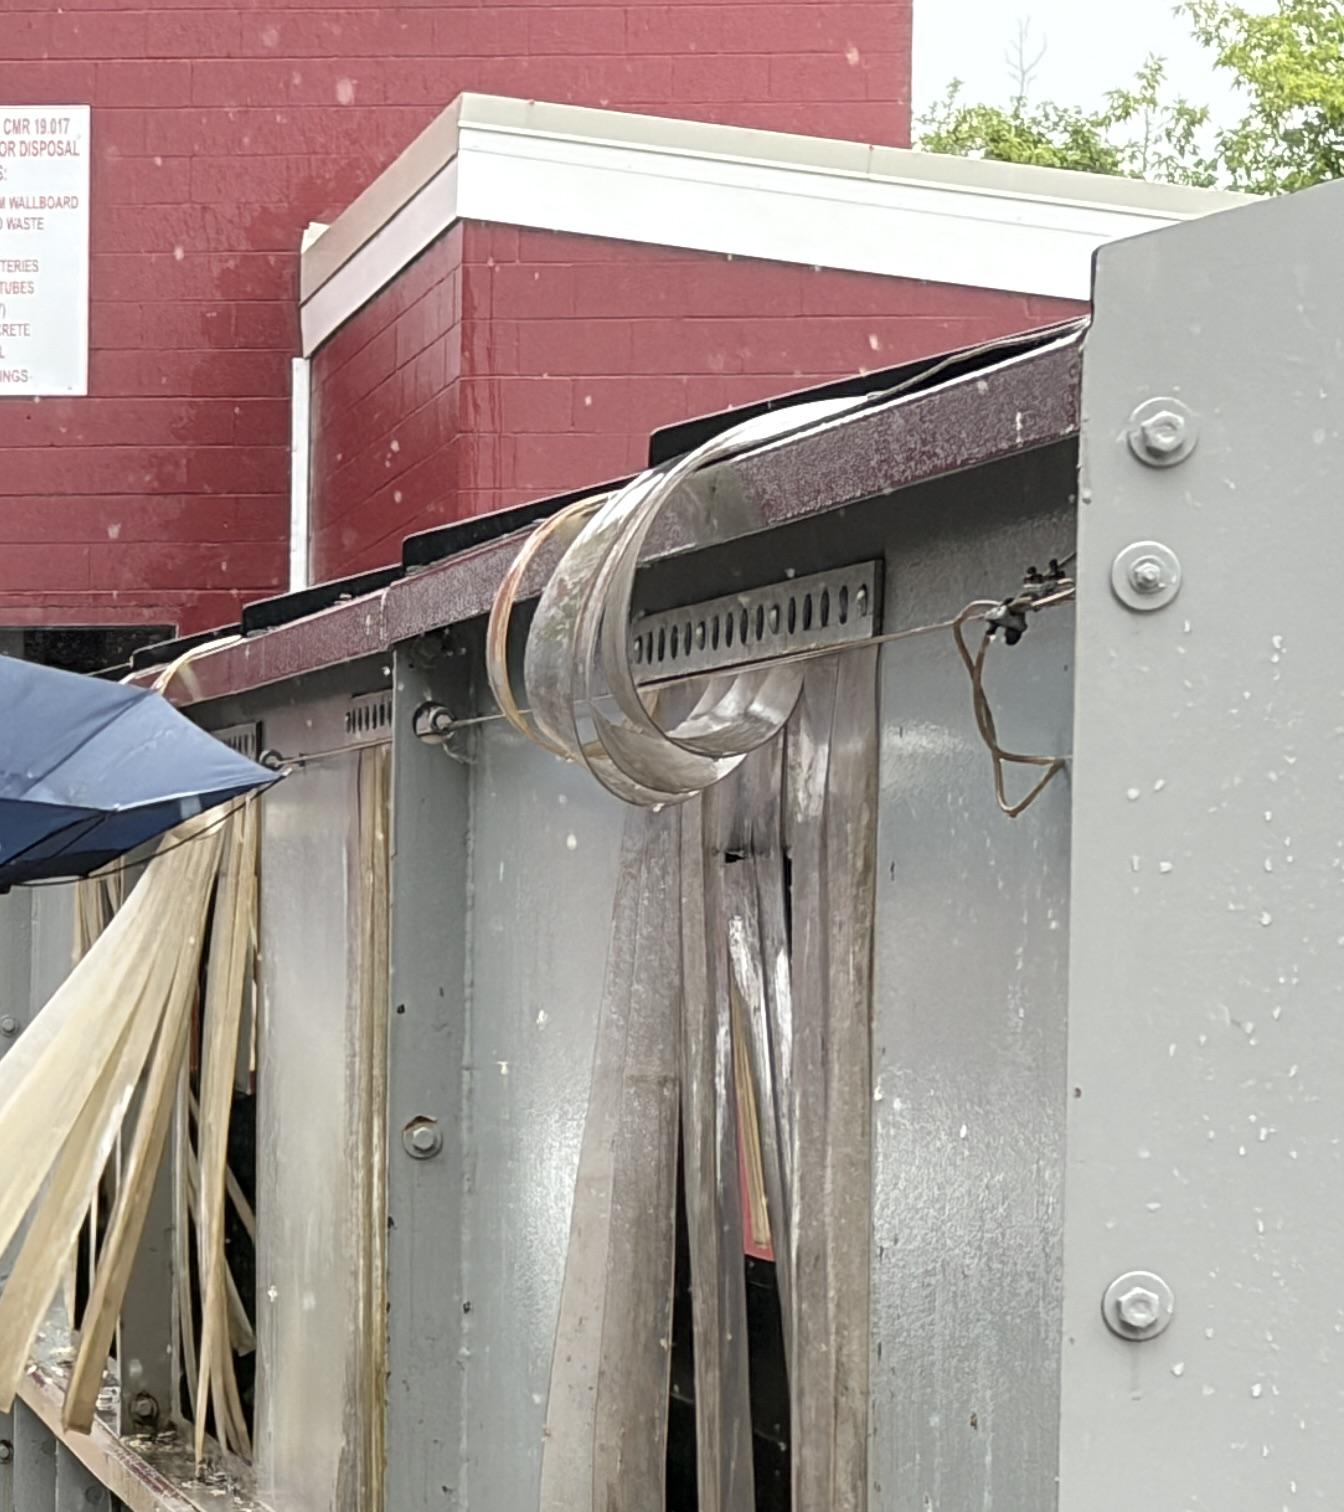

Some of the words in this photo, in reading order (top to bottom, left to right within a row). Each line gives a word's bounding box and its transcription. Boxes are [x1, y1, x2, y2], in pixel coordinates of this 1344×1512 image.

[4, 118, 30, 135] CMR
[35, 118, 70, 134] 19.017
[20, 140, 80, 157] DISPOSAL
[9, 196, 79, 209] WALLBOARD
[7, 217, 44, 230] WASTE
